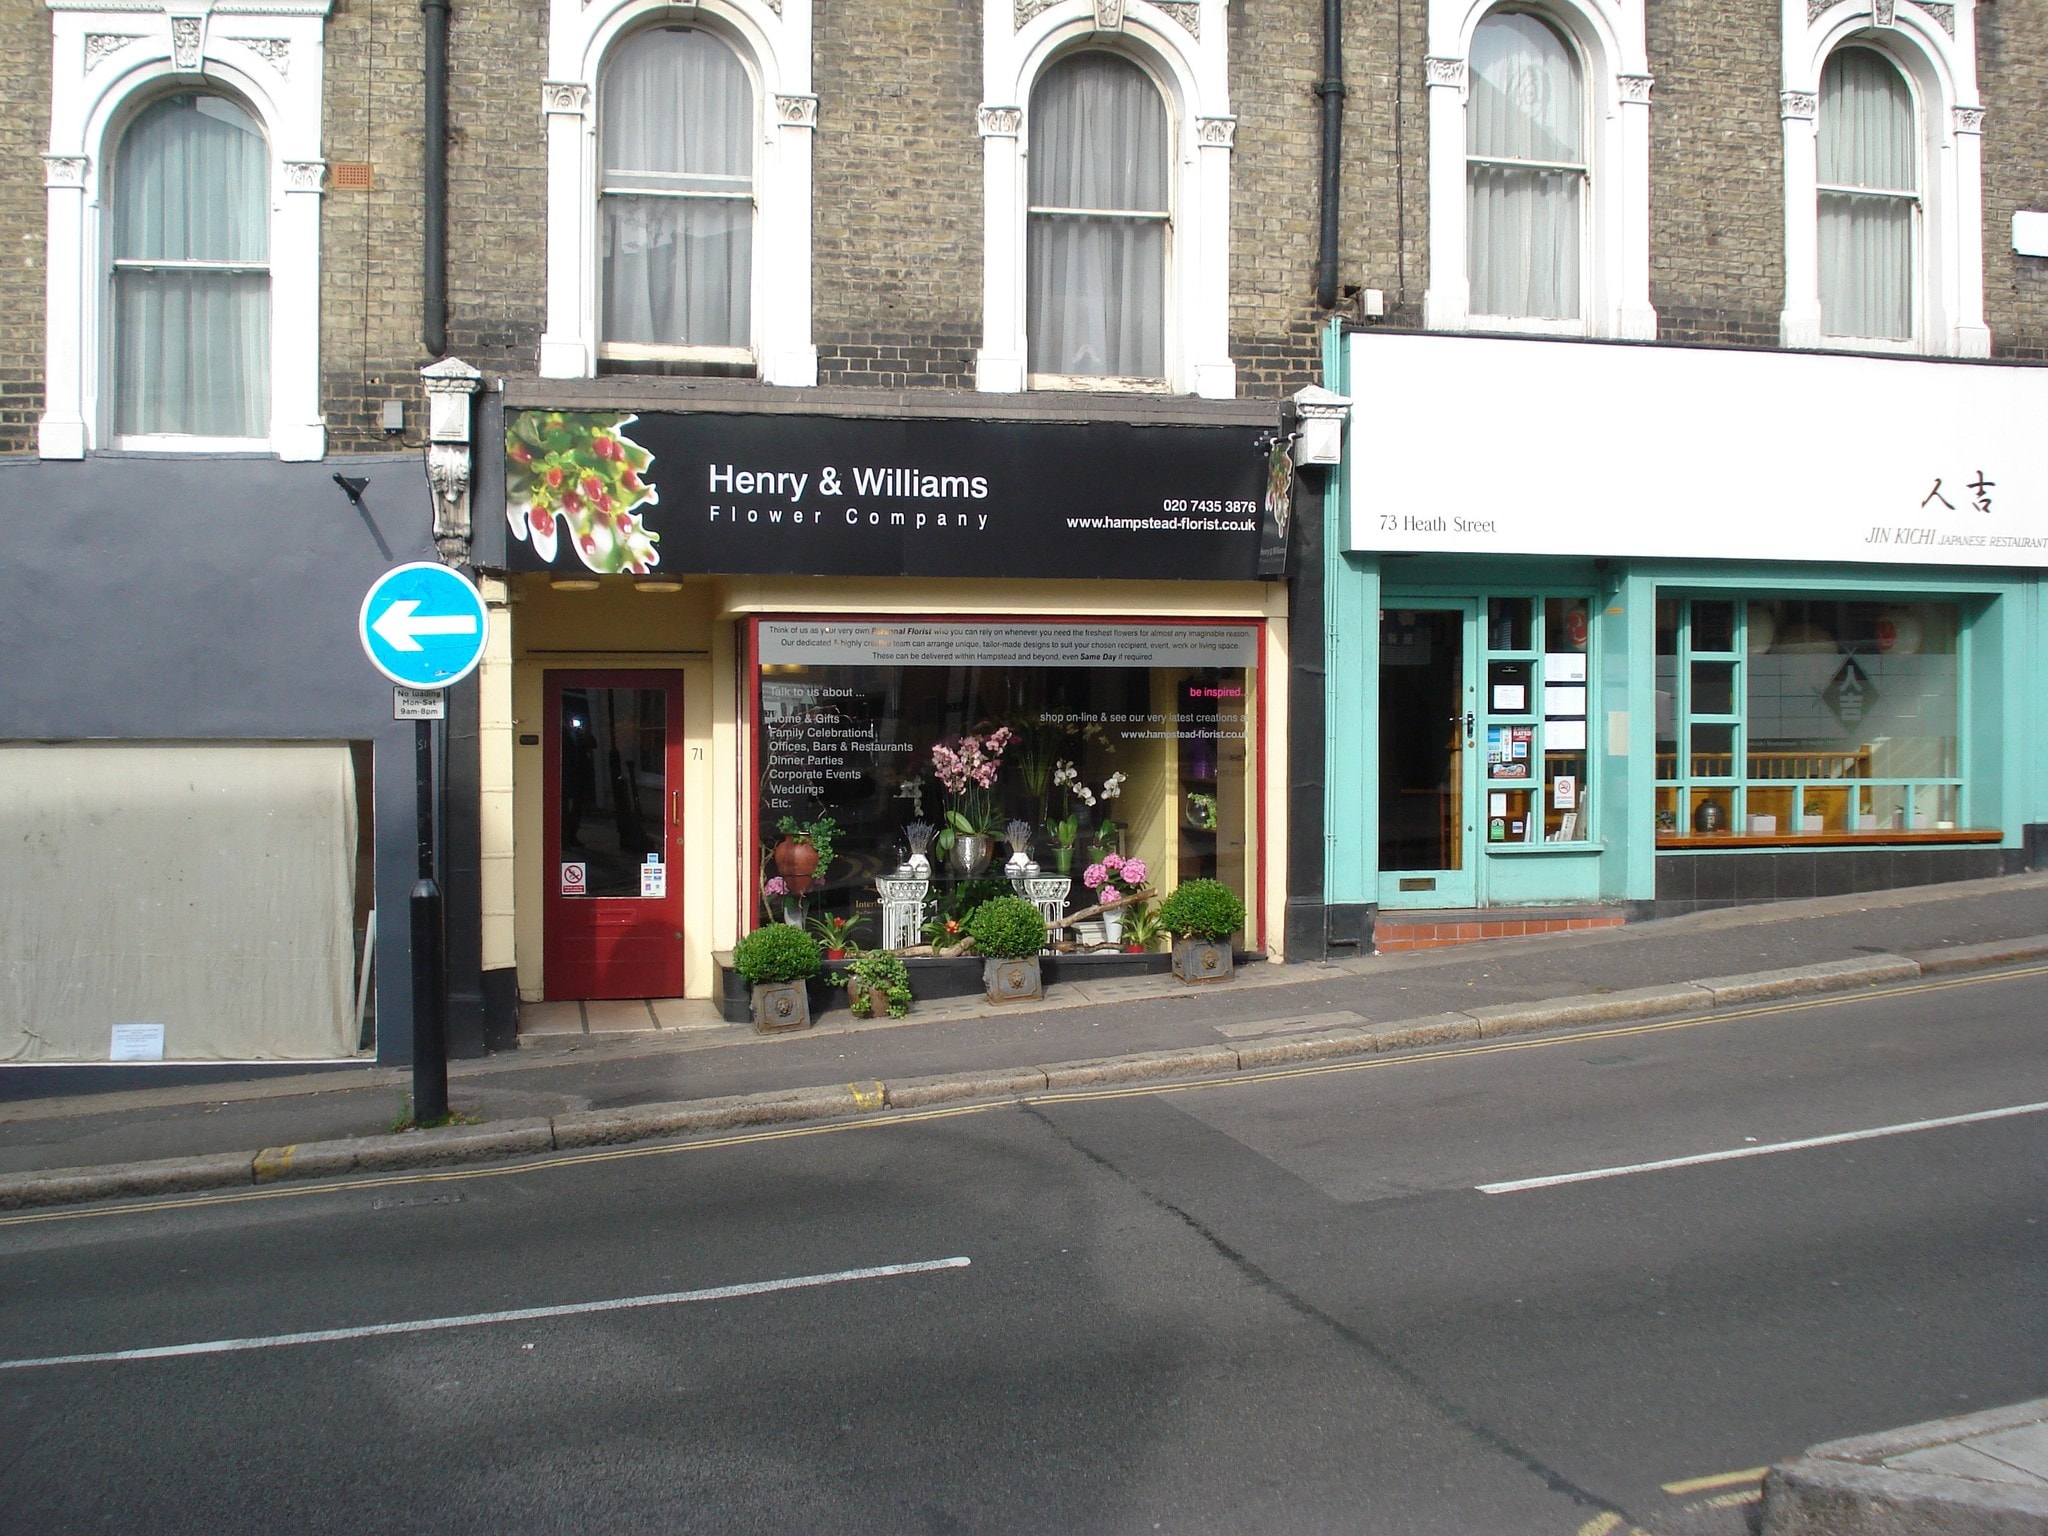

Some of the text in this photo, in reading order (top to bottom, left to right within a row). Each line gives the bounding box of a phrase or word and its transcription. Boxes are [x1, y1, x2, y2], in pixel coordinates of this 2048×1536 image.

[709, 464, 989, 501] Henry & Williams
[1163, 499, 1256, 513] 020 7435 3876
[709, 504, 989, 530] Flower Company
[1066, 516, 1256, 532] www.hampstead-florist.co.uk
[1379, 514, 1497, 533] 73 Heath Street
[1865, 527, 2048, 549] JIN KICHI JAPANESE RESTAURANT
[770, 626, 788, 634] Think
[791, 626, 798, 634] of
[820, 627, 836, 635] your
[838, 628, 852, 636] very
[907, 628, 931, 636] Florist
[950, 629, 963, 637] you
[979, 629, 991, 637] rely
[1039, 630, 1052, 638] you
[1054, 629, 1070, 637] need
[1073, 629, 1083, 637] the
[1085, 629, 1112, 637] freshest
[1114, 629, 1138, 637] flowers
[1140, 630, 1149, 638] for
[1151, 630, 1173, 638] almost
[1175, 631, 1187, 639] any
[1189, 630, 1225, 639] imaginable
[797, 638, 831, 646] dedicated
[841, 639, 862, 648] highly
[927, 641, 953, 649] arrange
[1024, 640, 1050, 649] designs
[1074, 641, 1089, 649] your
[1118, 642, 1148, 650] recipient,
[1199, 642, 1216, 650] living
[921, 652, 952, 660] delivered
[955, 652, 974, 660] within
[977, 652, 1016, 661] Hampstead
[1033, 653, 1060, 661] beyond,
[1080, 653, 1100, 661] Same
[1103, 653, 1117, 661] Day
[412, 690, 441, 698] loading
[770, 687, 790, 696] Talk
[794, 688, 804, 696] to
[806, 689, 819, 697] us
[822, 687, 853, 697] about
[1190, 687, 1201, 697] be
[770, 713, 840, 724] Home & Gifts
[1040, 713, 1063, 722] shop
[1066, 713, 1098, 722] on-line
[1101, 713, 1107, 722] &
[1110, 714, 1126, 722] see
[1129, 714, 1144, 722] our
[1147, 714, 1166, 724] very
[1169, 714, 1193, 722] latest
[1196, 714, 1238, 722] creations
[770, 727, 873, 739] Family Celebrations
[770, 741, 913, 752] Offices, Bars & Restaurants
[691, 747, 703, 760] 71
[770, 755, 843, 765] Dinner Parties
[770, 769, 861, 780] Corporate Events
[772, 784, 824, 796] Weddings
[772, 799, 791, 808] Etc.
